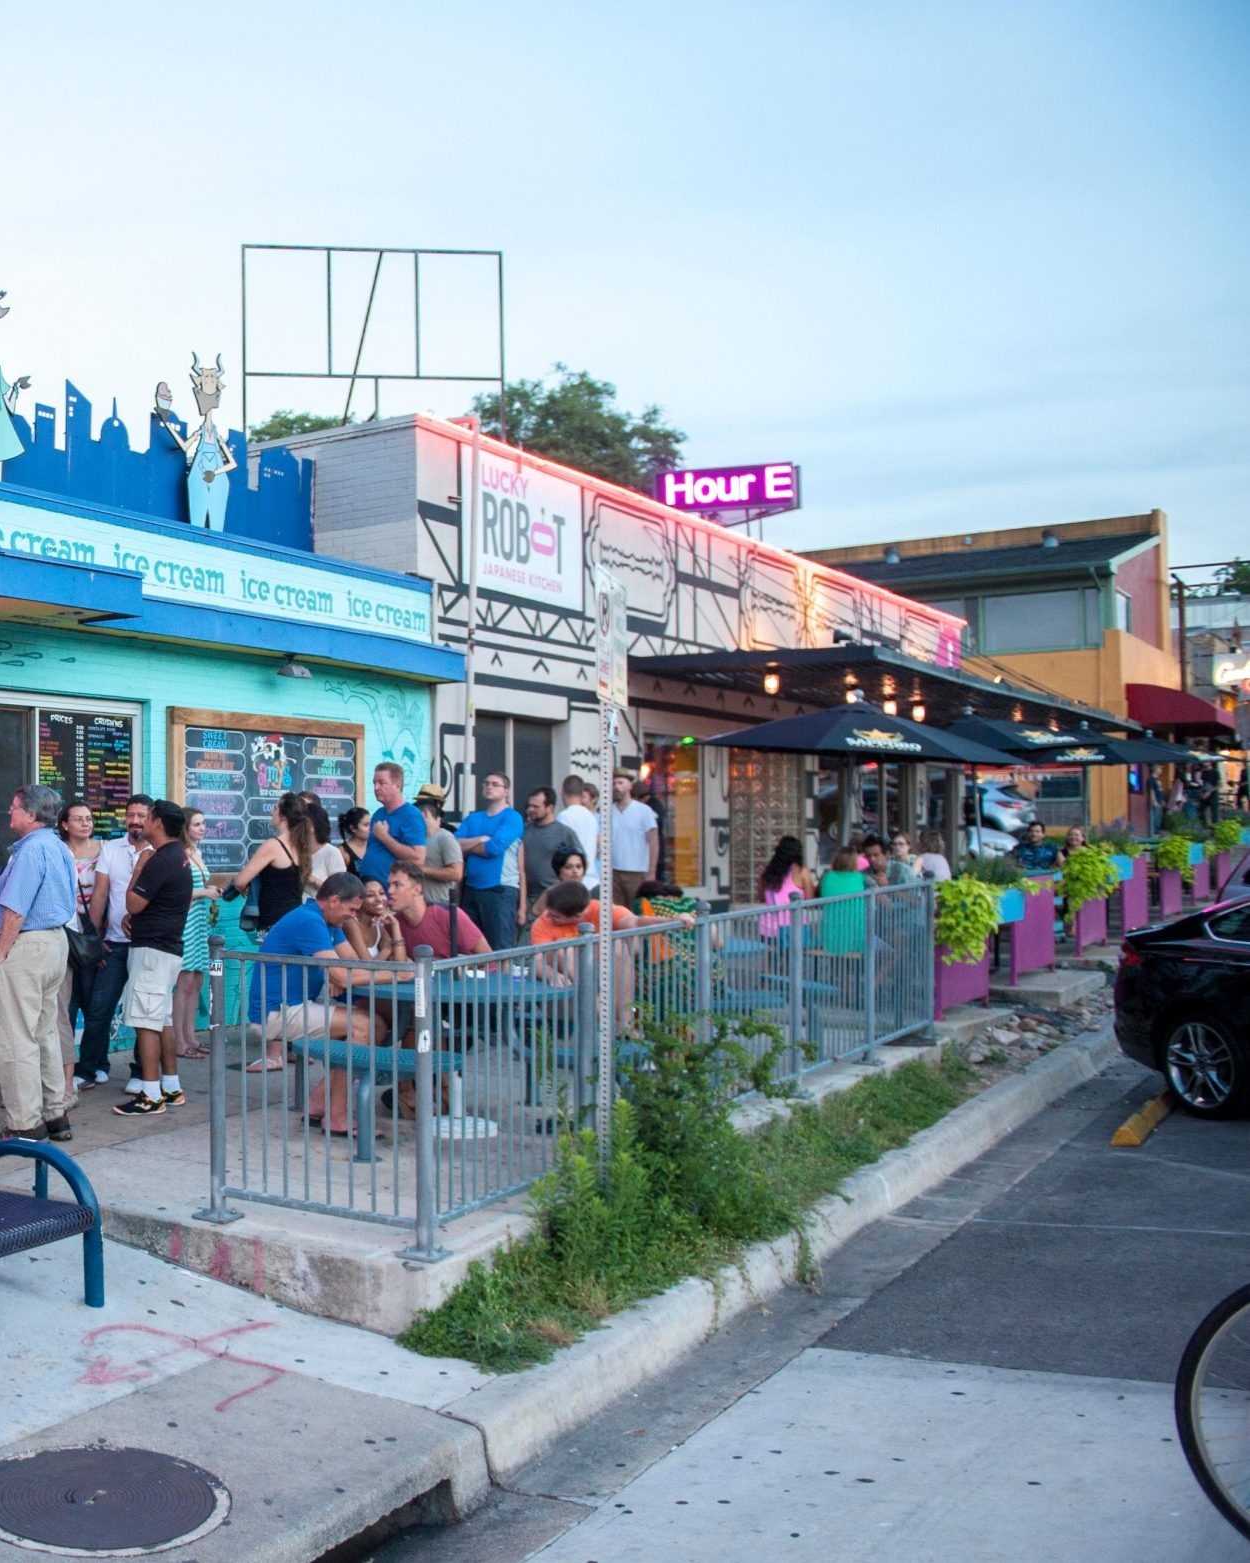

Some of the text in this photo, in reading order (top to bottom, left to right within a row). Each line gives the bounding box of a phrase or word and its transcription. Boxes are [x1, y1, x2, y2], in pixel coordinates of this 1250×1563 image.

[481, 463, 529, 499] LUCKY
[664, 466, 793, 506] Hour E
[9, 531, 95, 562] cream
[114, 543, 225, 595] ice cream
[482, 563, 563, 593] JAPANESE KITCHEN
[240, 570, 333, 613] ice cream
[346, 590, 427, 632] ice cream
[50, 714, 74, 724] PRICES
[203, 730, 227, 740] SWEET
[203, 740, 227, 749] CREAM
[317, 739, 342, 748] BELGIAN
[845, 737, 922, 752] SAPPORO
[312, 748, 345, 757] CHOCOLATE
[195, 761, 235, 770] CHOCOLATE
[317, 767, 341, 776] VANILLA
[200, 773, 230, 781] MEXICAN
[200, 782, 230, 790] VANILLA
